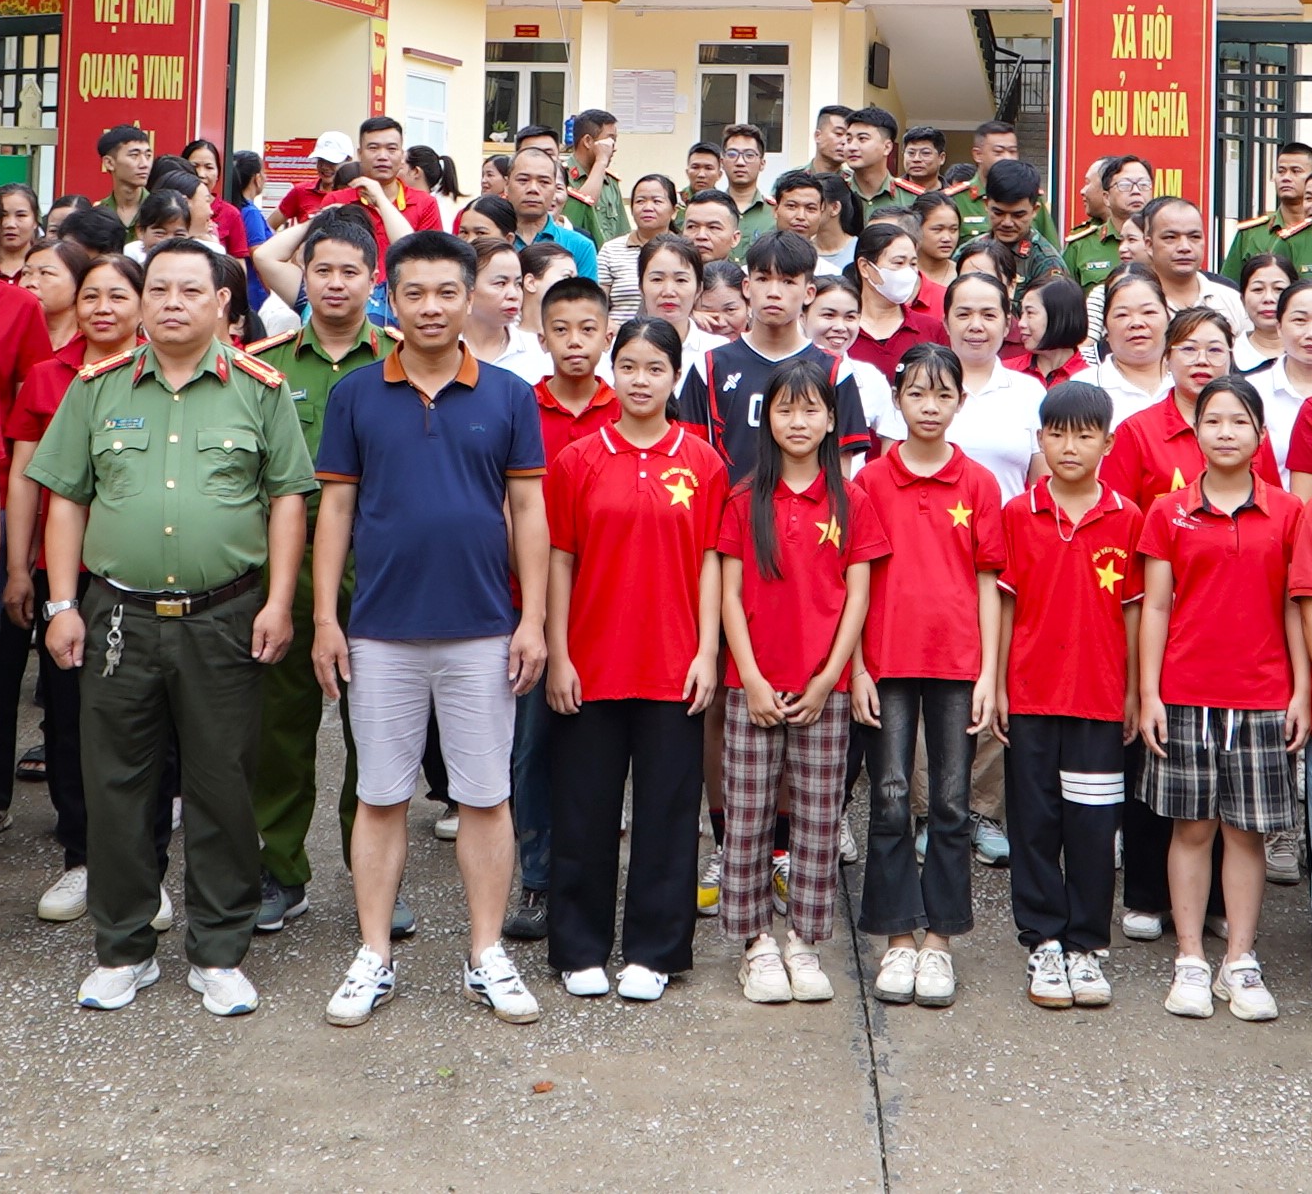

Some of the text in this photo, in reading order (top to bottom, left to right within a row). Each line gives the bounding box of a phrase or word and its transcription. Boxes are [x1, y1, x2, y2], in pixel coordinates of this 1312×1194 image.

[1111, 4, 1173, 70] XÃ HỘI
[79, 53, 184, 102] QUANG VINH
[1091, 71, 1189, 137] CHỦ NGHĨA
[1154, 168, 1183, 199] AM
